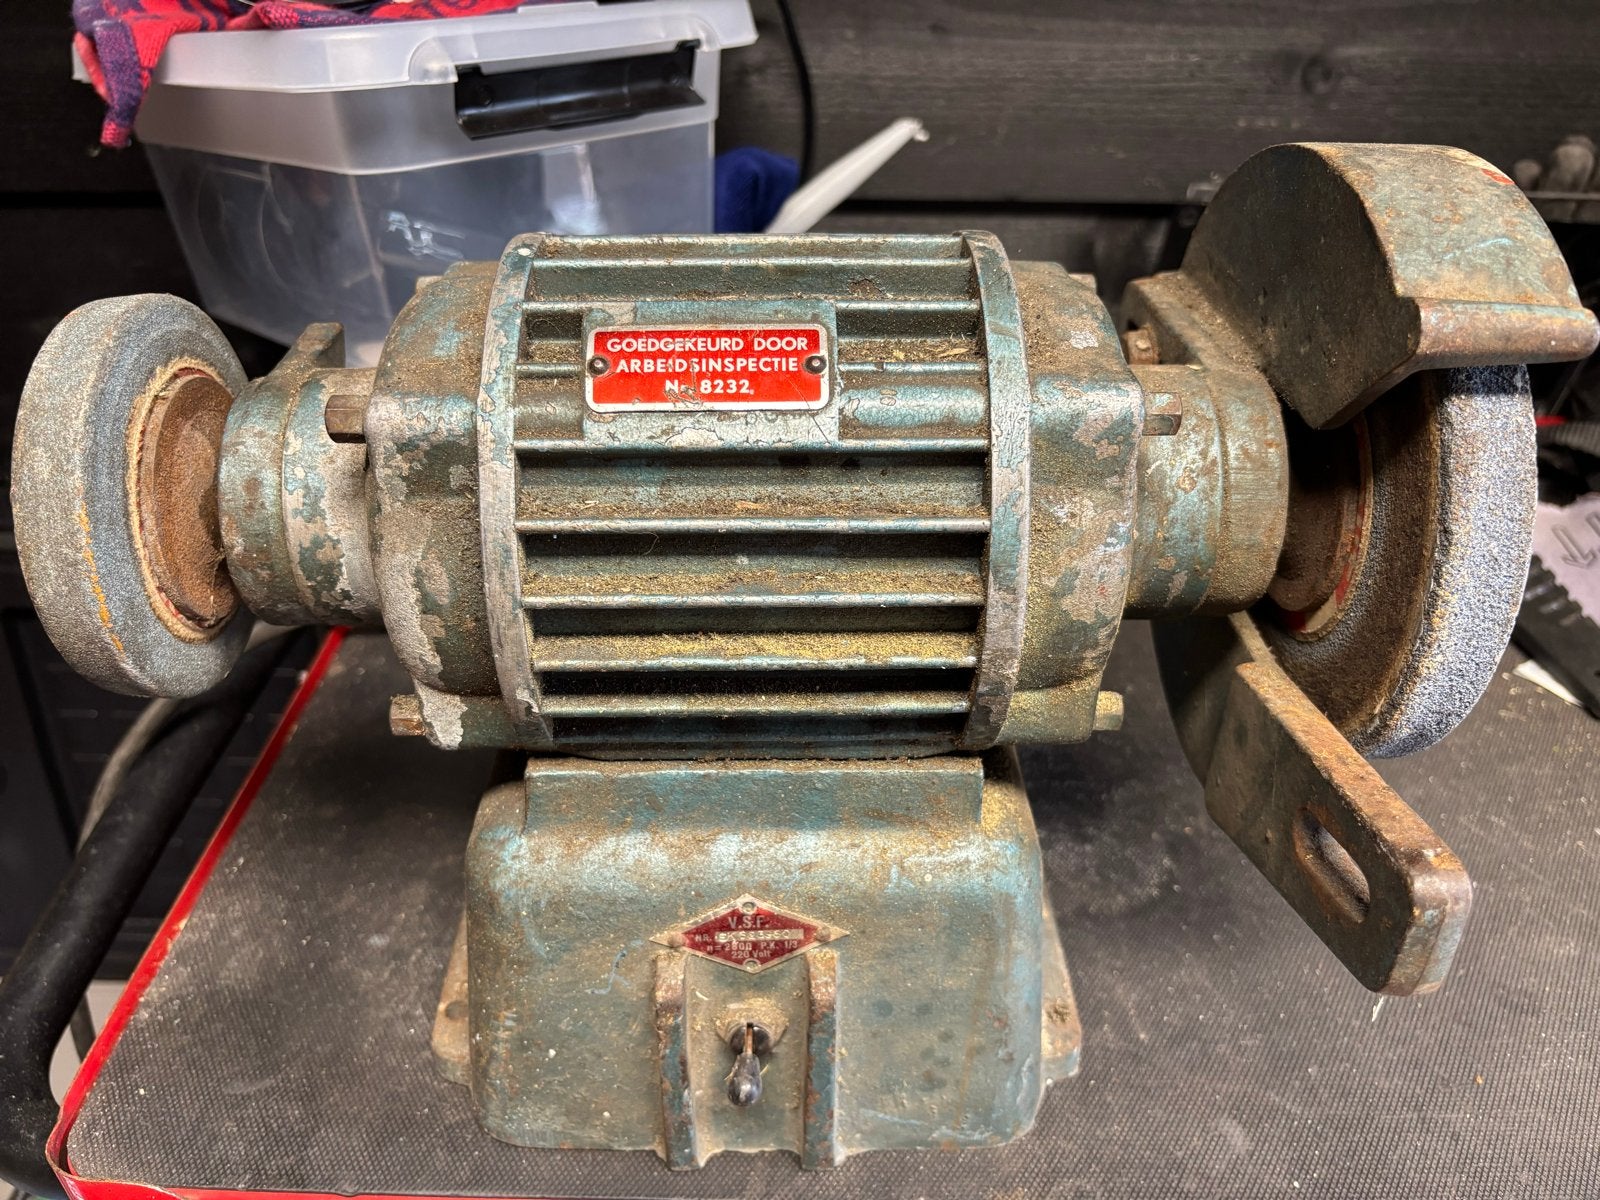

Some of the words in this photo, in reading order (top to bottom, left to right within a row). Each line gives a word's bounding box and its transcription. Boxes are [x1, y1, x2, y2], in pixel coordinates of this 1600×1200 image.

[607, 338, 744, 352] GOEDGEKEURD
[753, 337, 808, 351] DOOR
[616, 357, 798, 373] ARBEIDSINSPECTIE
[731, 951, 750, 959] 220
